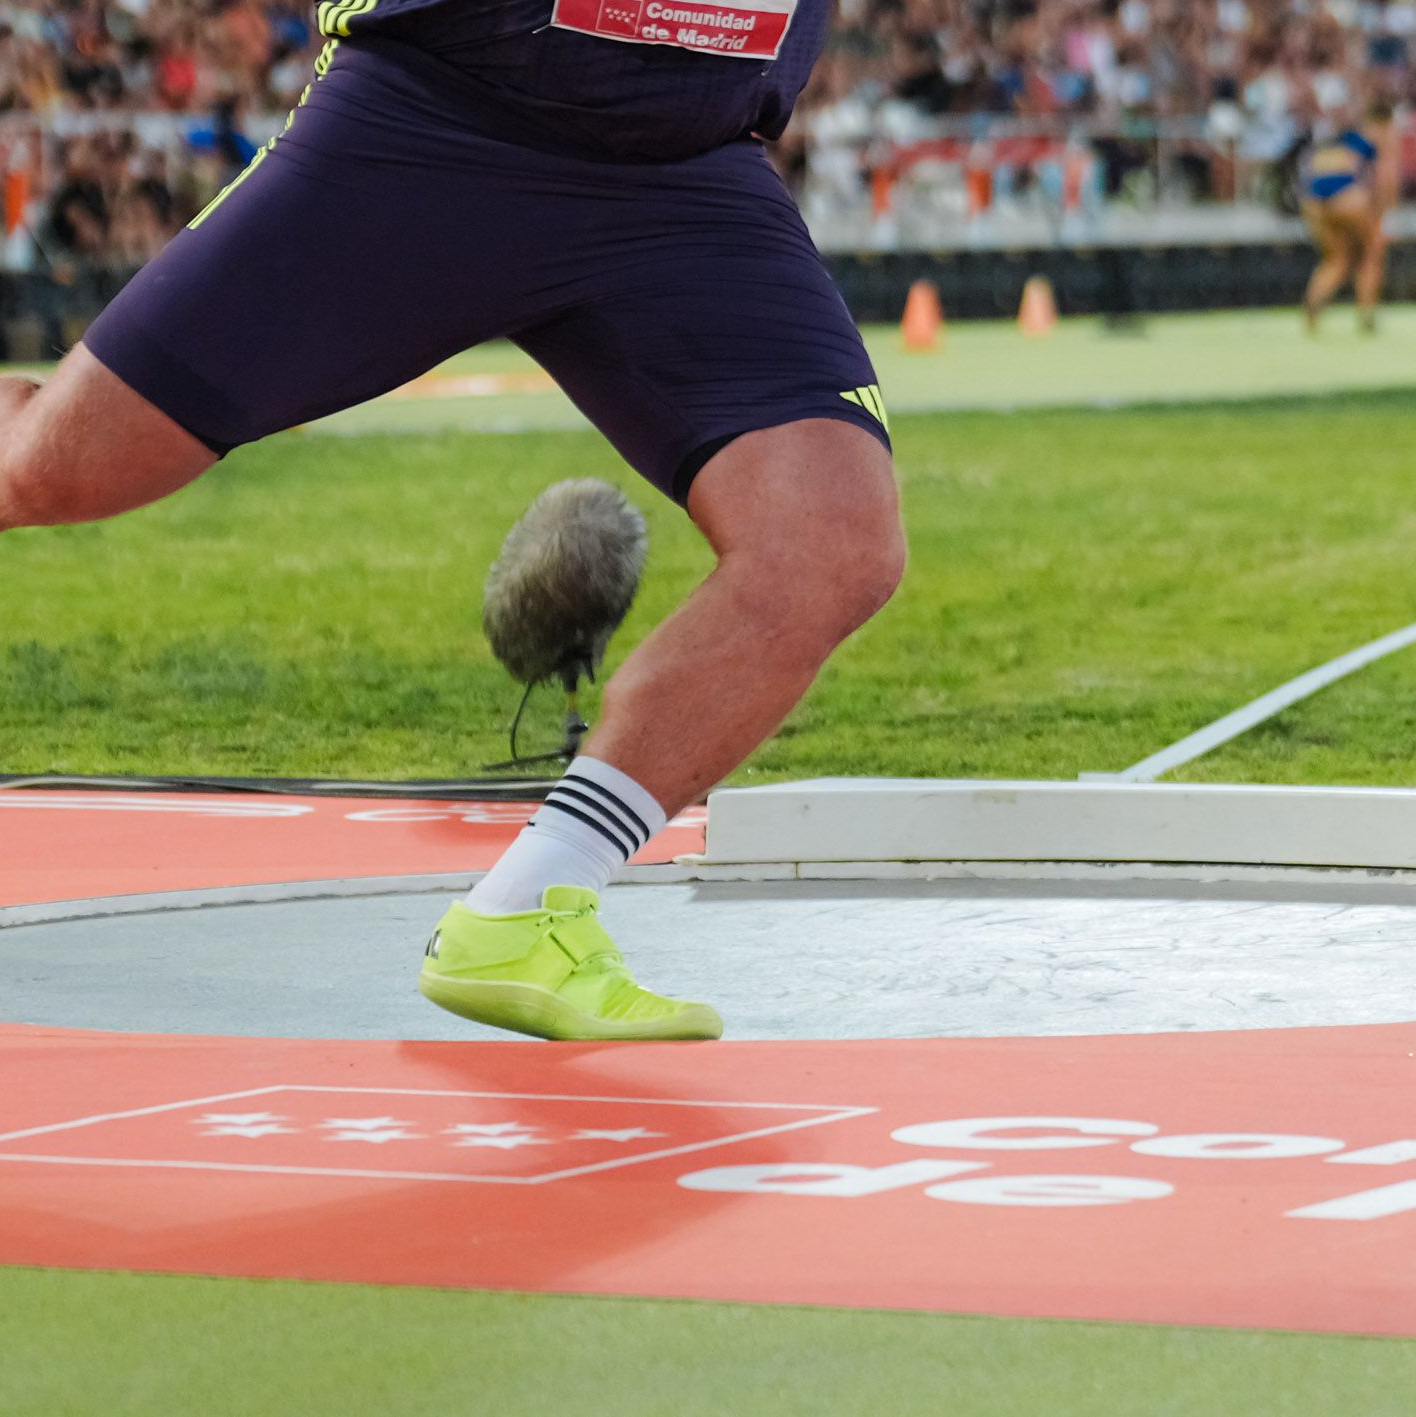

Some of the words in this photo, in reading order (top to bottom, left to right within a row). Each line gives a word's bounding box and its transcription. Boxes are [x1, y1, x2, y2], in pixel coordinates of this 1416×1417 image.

[646, 1, 756, 31] Comunidad
[641, 23, 670, 40] de
[676, 28, 749, 50] Madrid
[676, 1158, 1175, 1207] de
